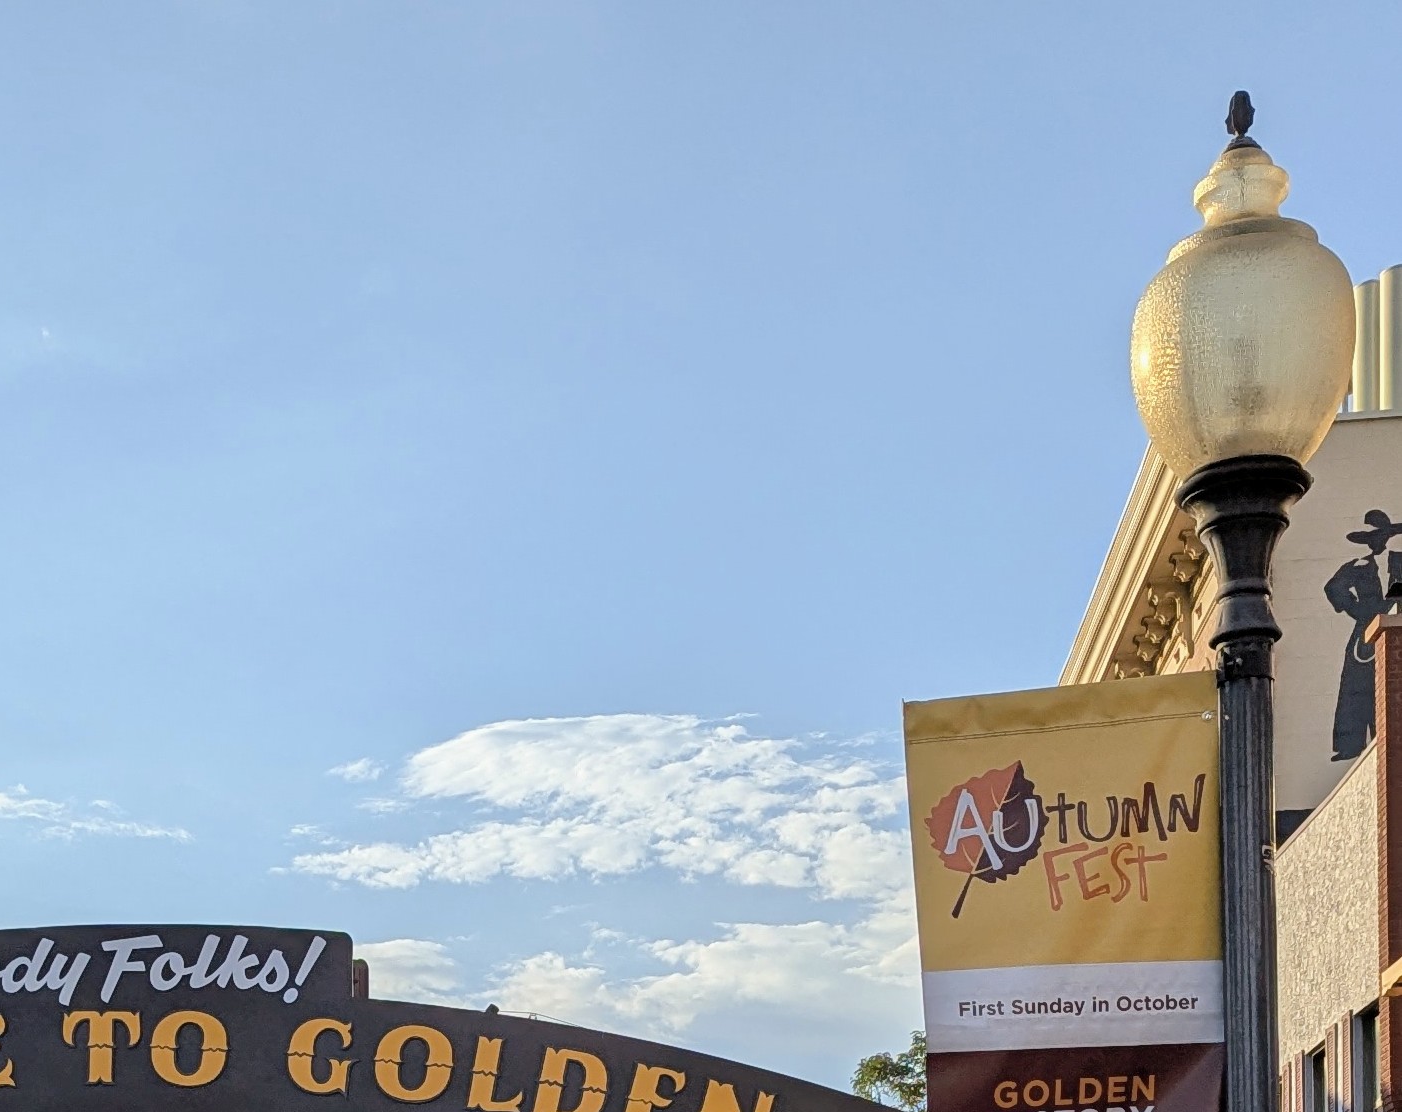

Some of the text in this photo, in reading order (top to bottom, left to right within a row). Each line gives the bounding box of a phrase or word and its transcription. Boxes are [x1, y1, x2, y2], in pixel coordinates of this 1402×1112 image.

[100, 934, 327, 1004] Folks!
[959, 994, 1199, 1017] First Sunday in October
[62, 1010, 230, 1087] TO
[993, 1074, 1156, 1108] GOLDEN
